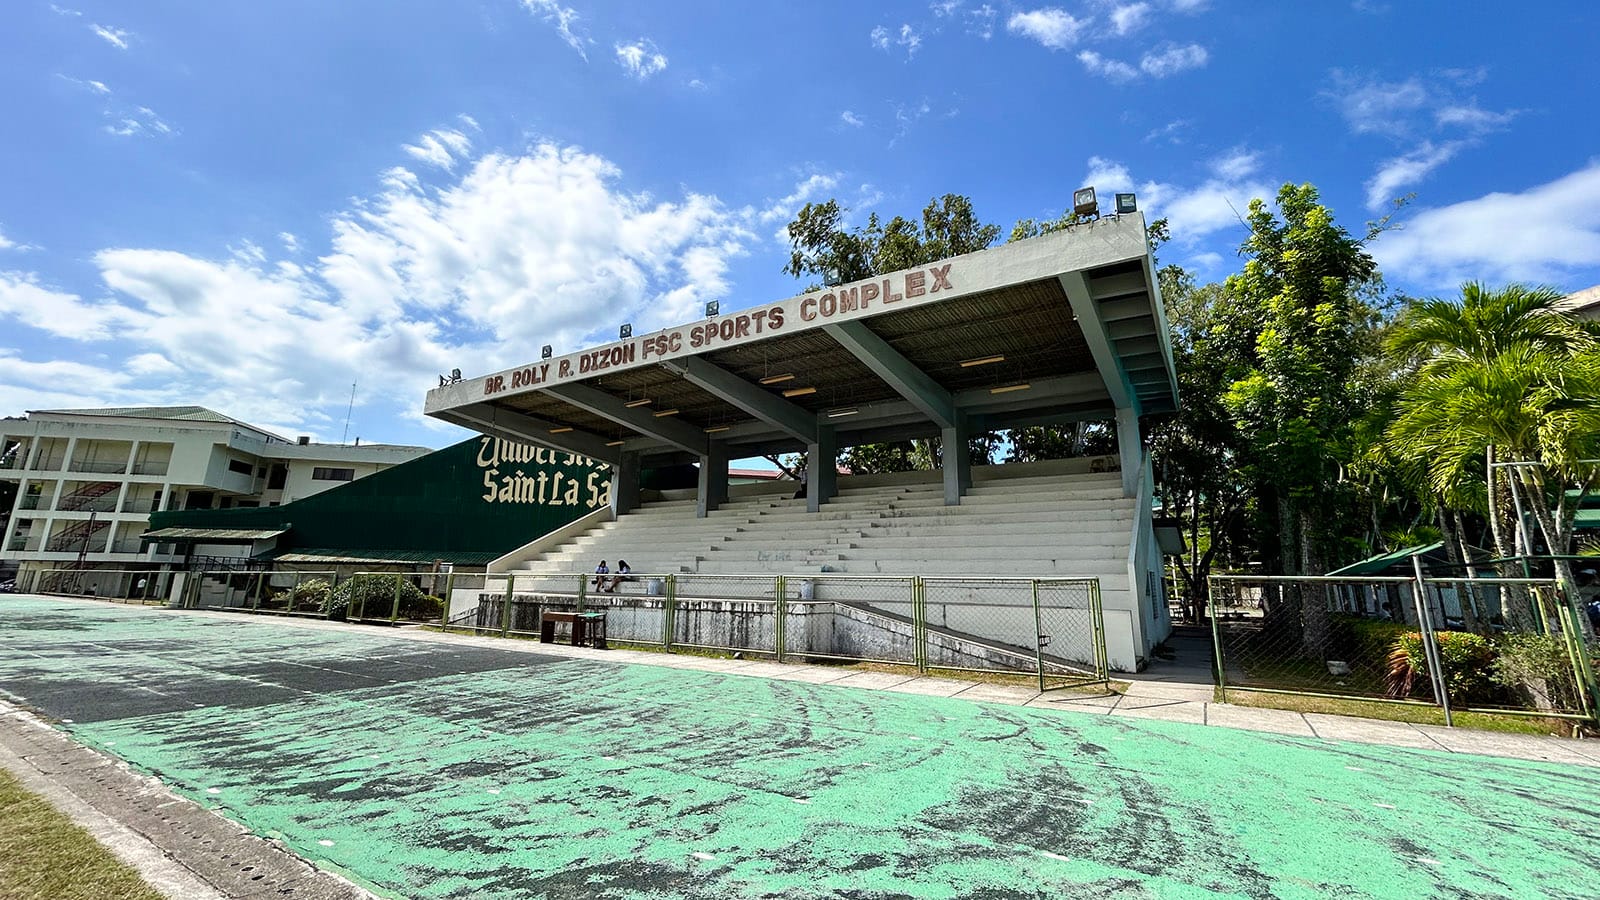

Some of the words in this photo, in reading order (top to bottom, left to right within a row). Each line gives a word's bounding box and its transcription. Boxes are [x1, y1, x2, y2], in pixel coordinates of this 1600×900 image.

[484, 375, 507, 395] BR.
[511, 363, 550, 389] ROLY
[558, 359, 575, 379] R.
[579, 342, 635, 374] DIZON
[642, 331, 682, 360] FSC
[689, 306, 785, 348] SPORTS
[800, 263, 953, 322] COMPLEX
[476, 437, 611, 471] Unive
[482, 468, 550, 503] Saint
[548, 471, 579, 506] La
